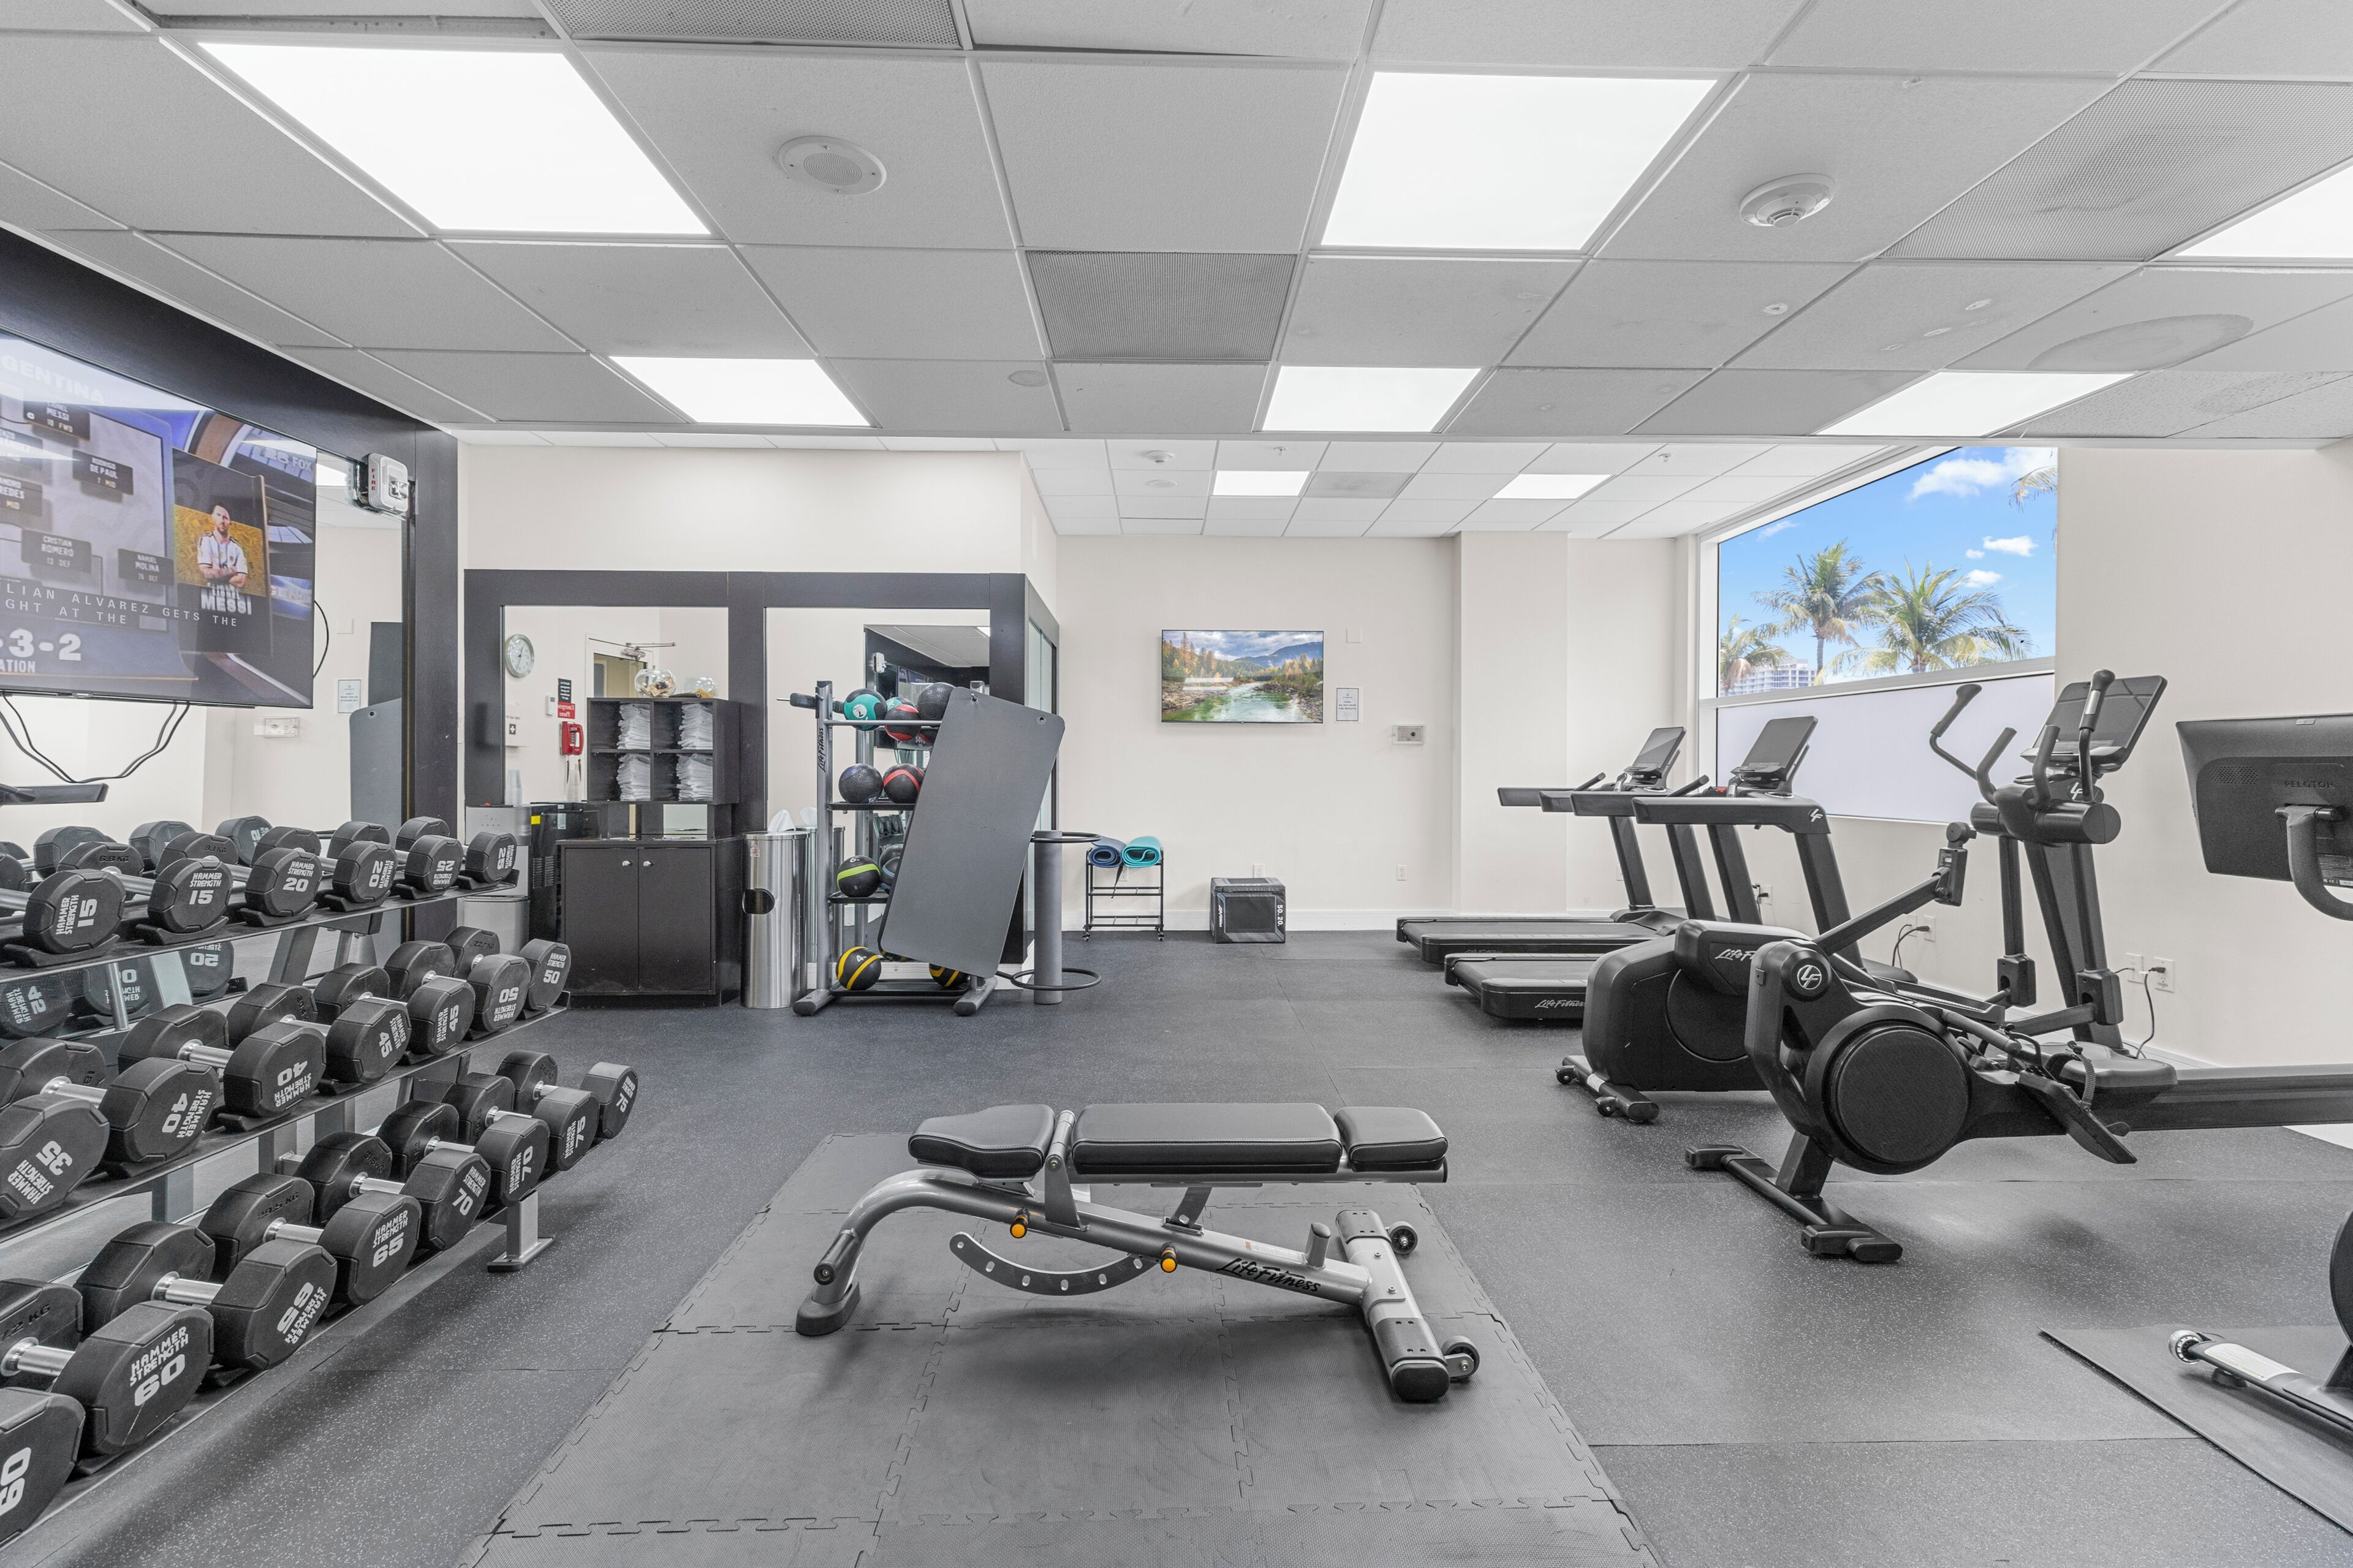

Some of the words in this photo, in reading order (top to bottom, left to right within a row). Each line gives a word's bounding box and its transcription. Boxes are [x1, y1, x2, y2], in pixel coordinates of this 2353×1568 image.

[292, 455, 311, 471] FOX
[41, 543, 74, 557] ROMERO
[135, 561, 160, 572] MOLINA
[5, 598, 42, 613] GHT
[59, 606, 80, 618] AT
[96, 611, 126, 624] THE
[7, 583, 55, 600] LIAN
[71, 593, 149, 613] ALVAREZ
[162, 607, 200, 621] GETS
[213, 615, 237, 627] THE
[201, 589, 252, 615] MESSI
[0, 629, 82, 661] 3-2
[2284, 781, 2335, 789] PELOTON
[290, 861, 314, 871] HAMMER
[436, 860, 455, 871] 25
[497, 847, 506, 869] 25
[282, 877, 309, 892] 20
[287, 868, 314, 877] STRENGTH
[369, 860, 383, 887] 20
[379, 860, 390, 888] STRENGTH
[384, 860, 394, 887] HAMMER
[189, 890, 214, 905] 15
[56, 897, 70, 934] HAMMER
[64, 895, 79, 934] STRENGTH
[77, 898, 97, 927] 15
[547, 960, 565, 969] STRENGTH
[550, 953, 567, 961] HAMMER
[544, 969, 560, 984] 50
[499, 987, 519, 1003] 50
[449, 1004, 459, 1032] 45
[493, 1011, 514, 1022] HAMMER
[494, 1004, 517, 1015] STRENGTH
[390, 1018, 401, 1049] STRENGTH
[395, 1013, 406, 1043] HAMMER
[379, 1032, 393, 1058] 45
[277, 1061, 308, 1086] 40
[275, 1073, 311, 1102] STRENGTH
[276, 1081, 311, 1107] HAMMER
[162, 1093, 188, 1133] 40
[176, 1089, 205, 1138] STRENGTH
[185, 1091, 212, 1137] HAMMER
[616, 1093, 629, 1112] 75
[575, 1116, 586, 1148] 75
[36, 1140, 73, 1175] 35
[521, 1146, 533, 1181] 70
[7, 1170, 44, 1205] HAMMER
[16, 1159, 54, 1195] STRENGTH
[463, 1175, 483, 1197] STRENGTH
[469, 1166, 486, 1187] HAMMER
[285, 1192, 298, 1206] KG
[452, 1187, 473, 1216] 70
[373, 1217, 408, 1248] STRENGTH
[375, 1210, 408, 1238] HAMMER
[373, 1232, 404, 1267] 65
[29, 1303, 50, 1324] KG
[277, 1282, 314, 1334] 65
[284, 1287, 324, 1344] STRENGTH
[291, 1288, 327, 1344] HAMMER
[130, 1333, 189, 1387] STRENGTH
[131, 1326, 187, 1377] HAMMER
[134, 1354, 185, 1406] 60
